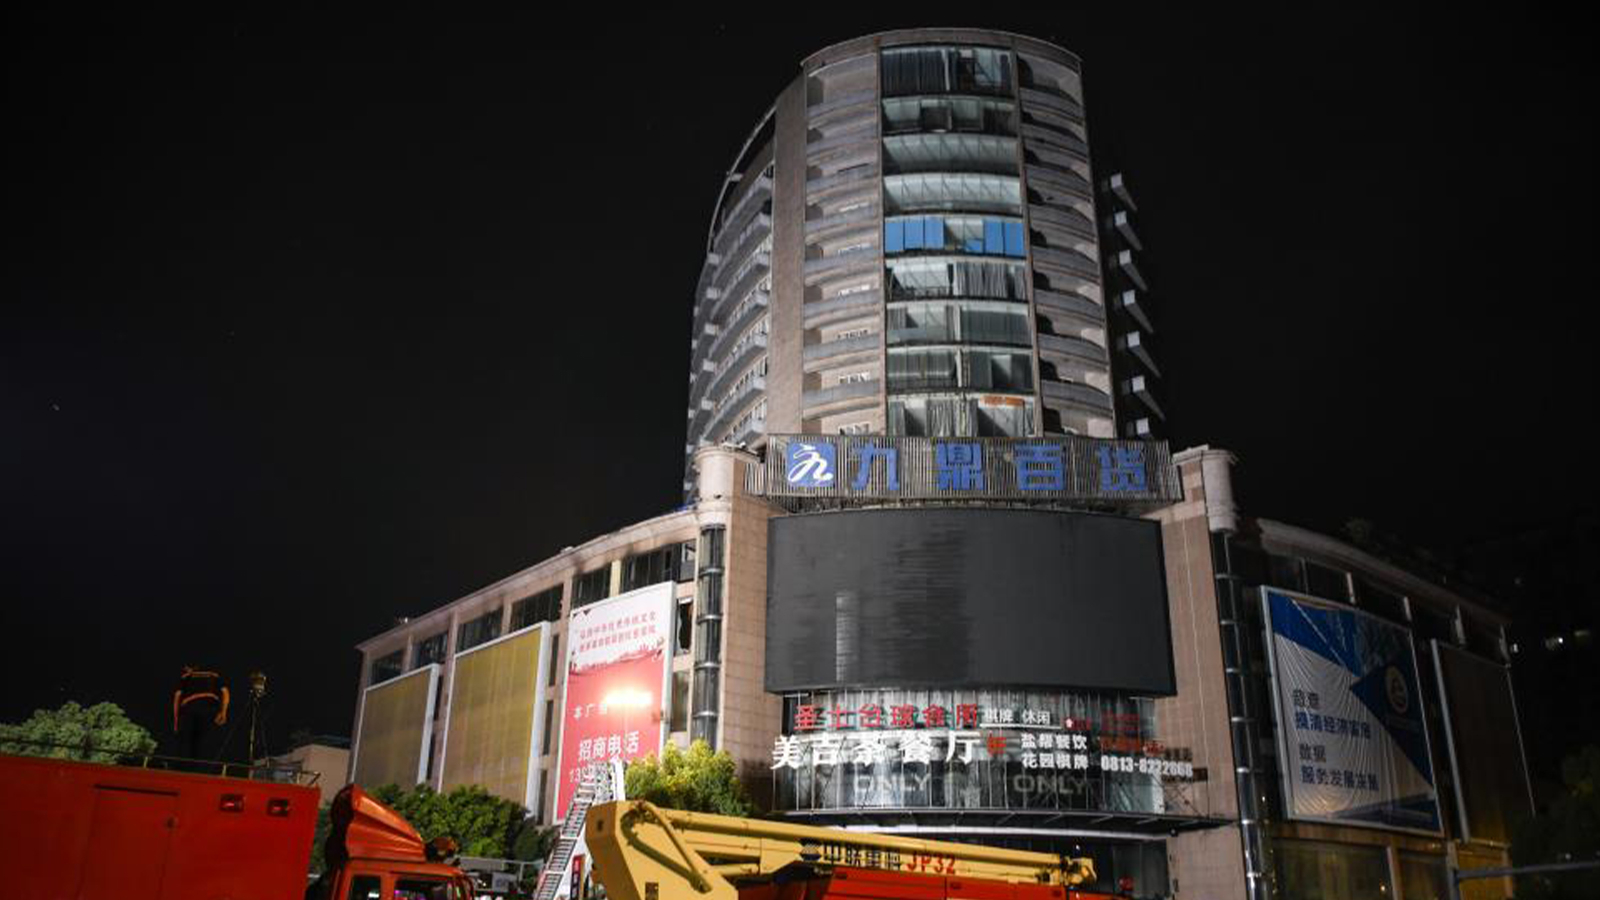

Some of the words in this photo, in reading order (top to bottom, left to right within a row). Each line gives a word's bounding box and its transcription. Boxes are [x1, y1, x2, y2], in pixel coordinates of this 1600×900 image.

[852, 443, 1149, 491] 九鼎百货
[1022, 709, 1051, 725] 休闲
[579, 730, 640, 760] 招商电话
[1012, 774, 1087, 796] ONLY
[906, 851, 956, 875] JP32
